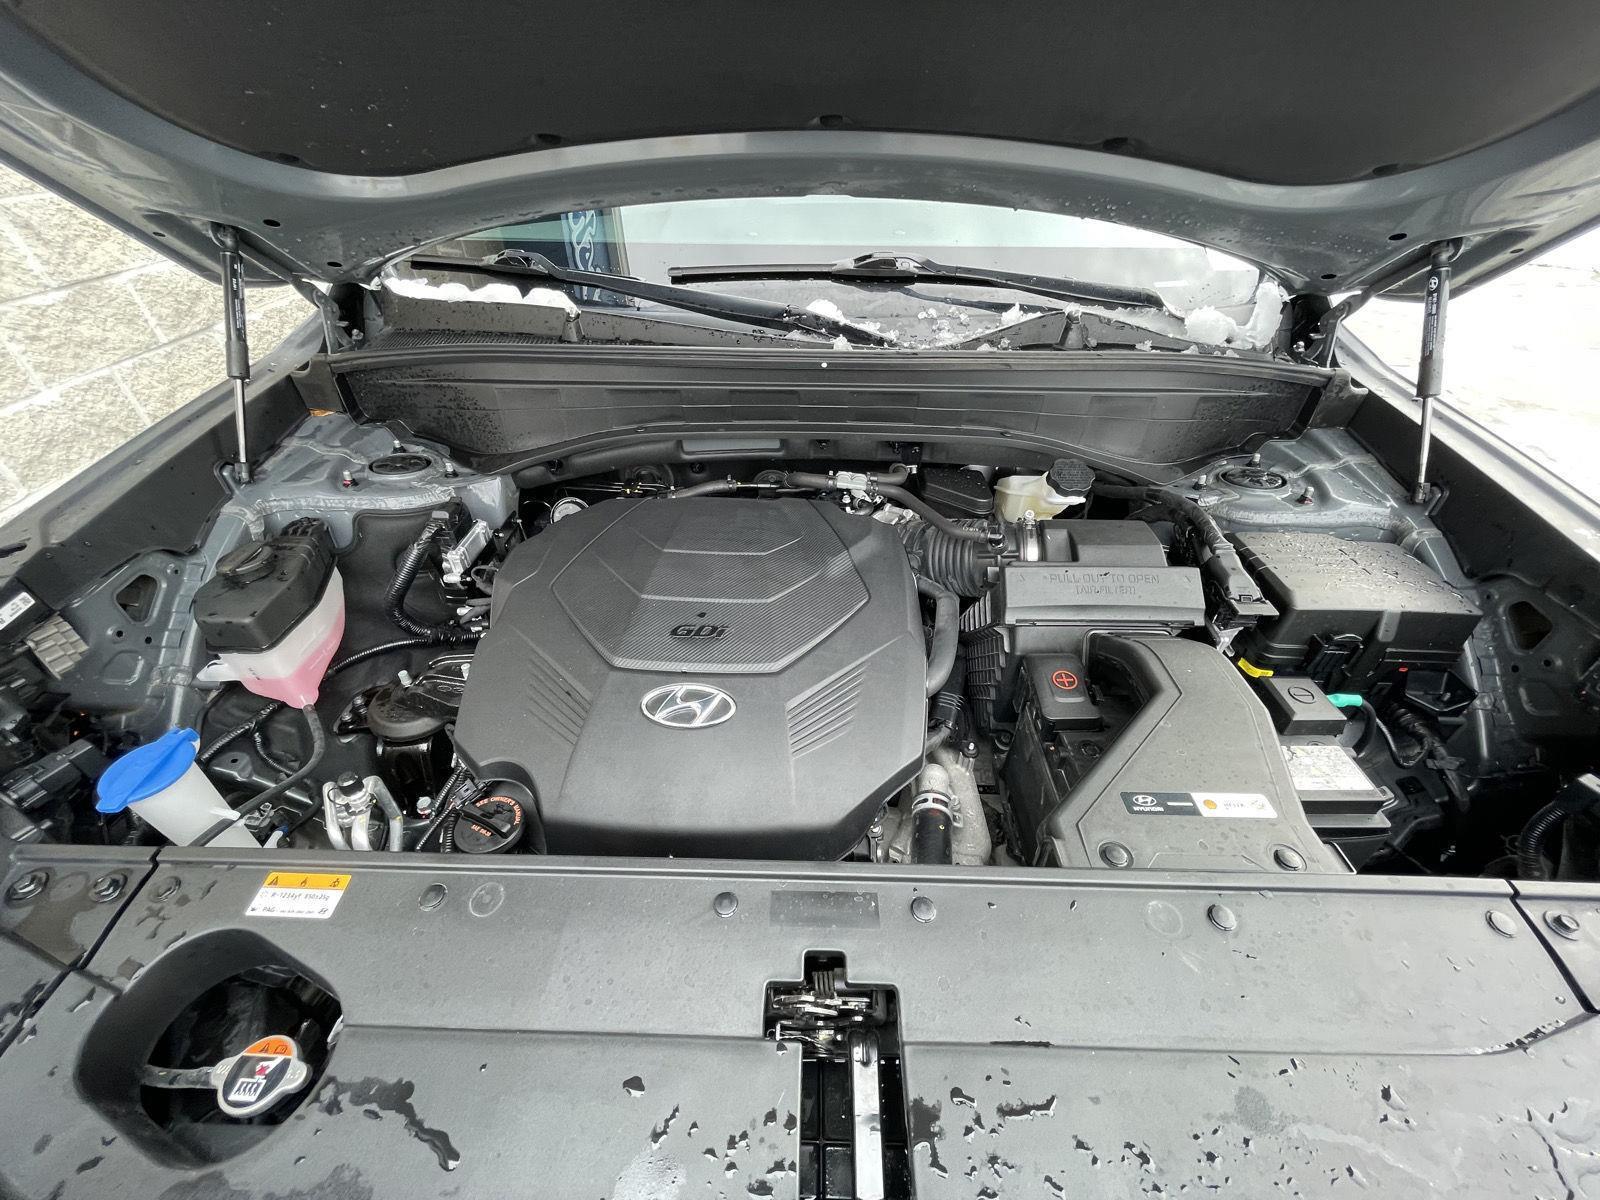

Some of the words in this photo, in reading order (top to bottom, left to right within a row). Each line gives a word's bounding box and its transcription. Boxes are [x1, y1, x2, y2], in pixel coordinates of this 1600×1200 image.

[1049, 573, 1080, 584] PULL
[1082, 573, 1106, 584] OUT
[1111, 573, 1125, 584] TO
[1128, 573, 1160, 584] OPEN
